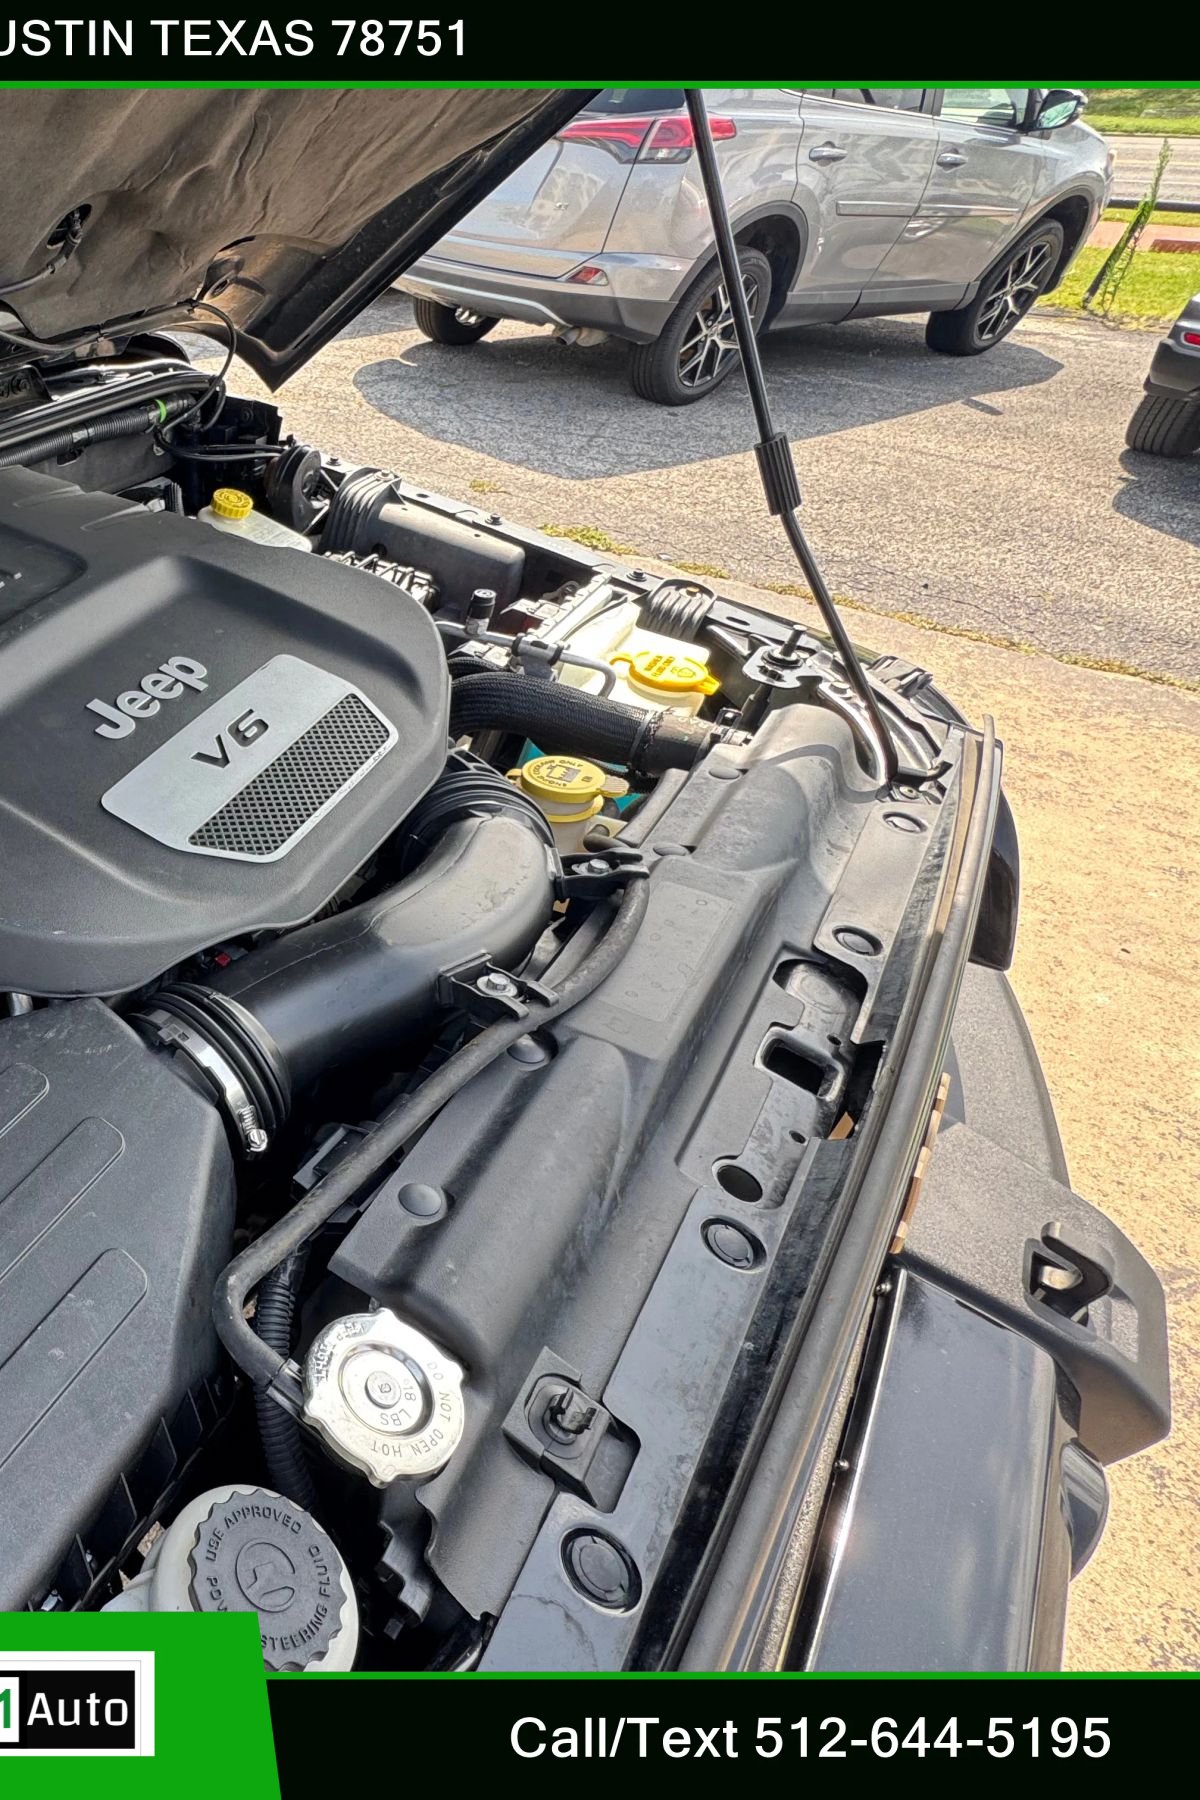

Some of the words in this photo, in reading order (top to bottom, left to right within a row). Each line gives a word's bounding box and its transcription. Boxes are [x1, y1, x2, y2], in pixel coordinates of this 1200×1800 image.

[86, 655, 209, 740] Jeep
[192, 708, 270, 768] V6
[427, 1361, 445, 1381] DO
[380, 1408, 411, 1426] LBS
[438, 1391, 452, 1422] NOT
[371, 1440, 402, 1458] HOT
[410, 1428, 444, 1456] OPEN
[205, 1527, 225, 1562] USE
[224, 1504, 302, 1534] APPROVED
[308, 1544, 331, 1598] FLUID
